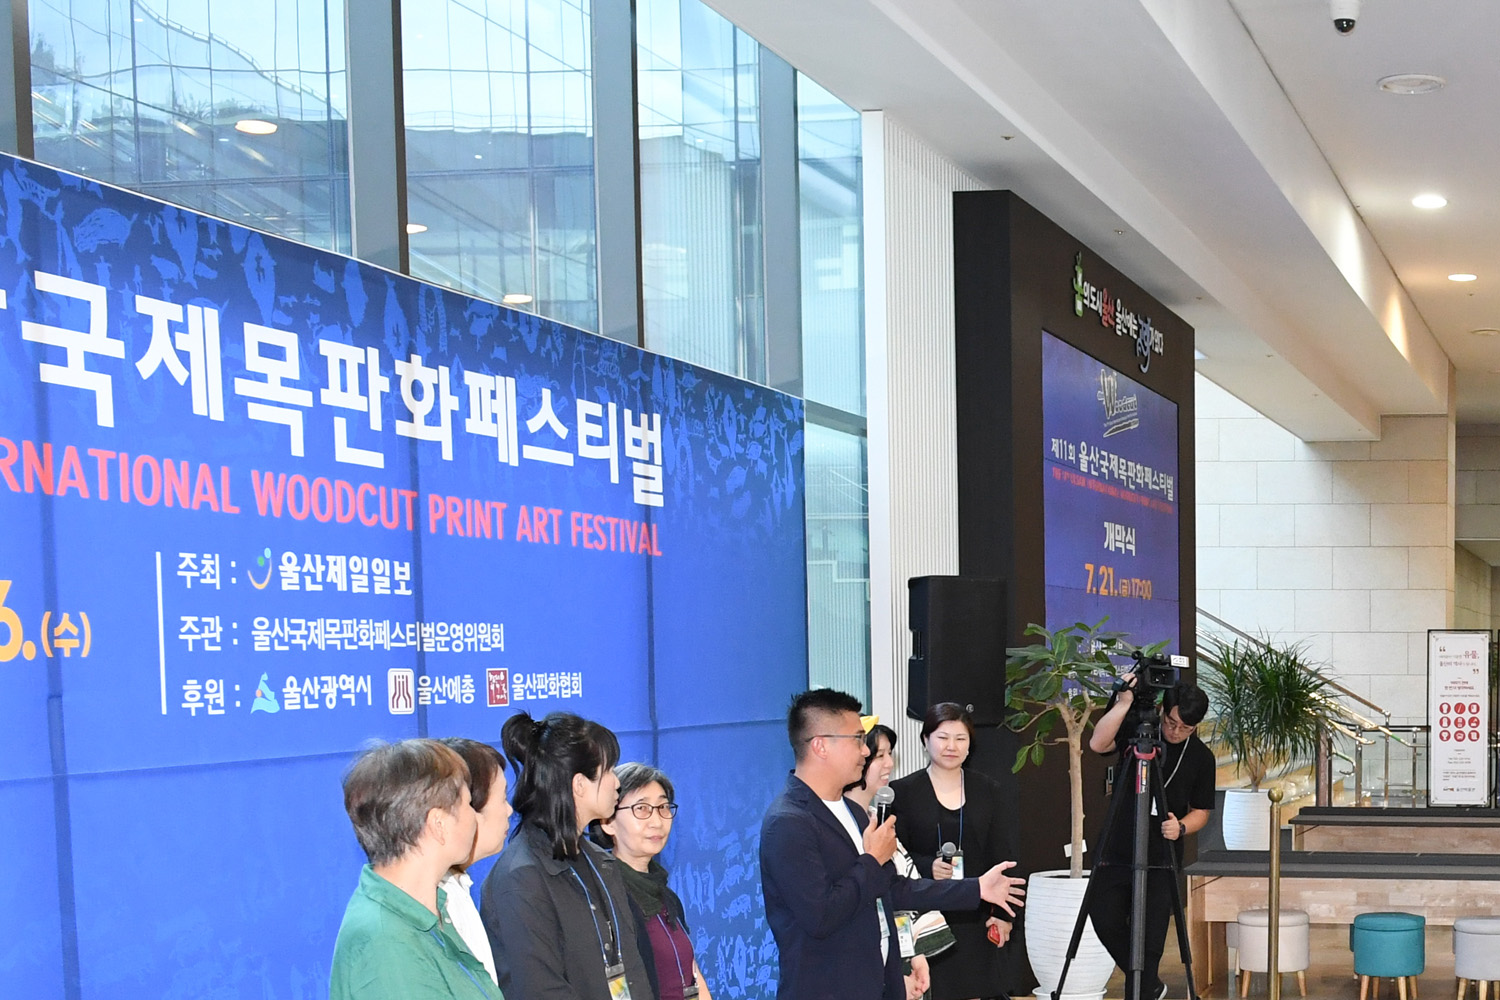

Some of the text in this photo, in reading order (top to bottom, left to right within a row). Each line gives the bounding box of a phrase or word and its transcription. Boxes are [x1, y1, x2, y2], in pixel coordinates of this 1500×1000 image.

[0, 270, 664, 507] 국제목판화페스티벌
[1051, 438, 1076, 464] 제11회
[1078, 441, 1174, 502] 울산국제목판화페스티벌
[251, 470, 418, 531] WOODCUT
[428, 494, 507, 540] PRINT
[516, 505, 562, 545] ART
[570, 511, 663, 556] FESTIVAL
[1103, 521, 1136, 556] 개막식
[177, 552, 221, 590] 주최
[278, 551, 413, 595] 울산제일일보
[178, 615, 223, 651] 주관
[251, 616, 505, 652] 울산국제목판화페스티벌운영위원회
[181, 679, 226, 717] 후원
[282, 674, 372, 710] 울산광역시
[417, 674, 475, 706] 울산예총
[511, 672, 582, 701] 울산판화협회
